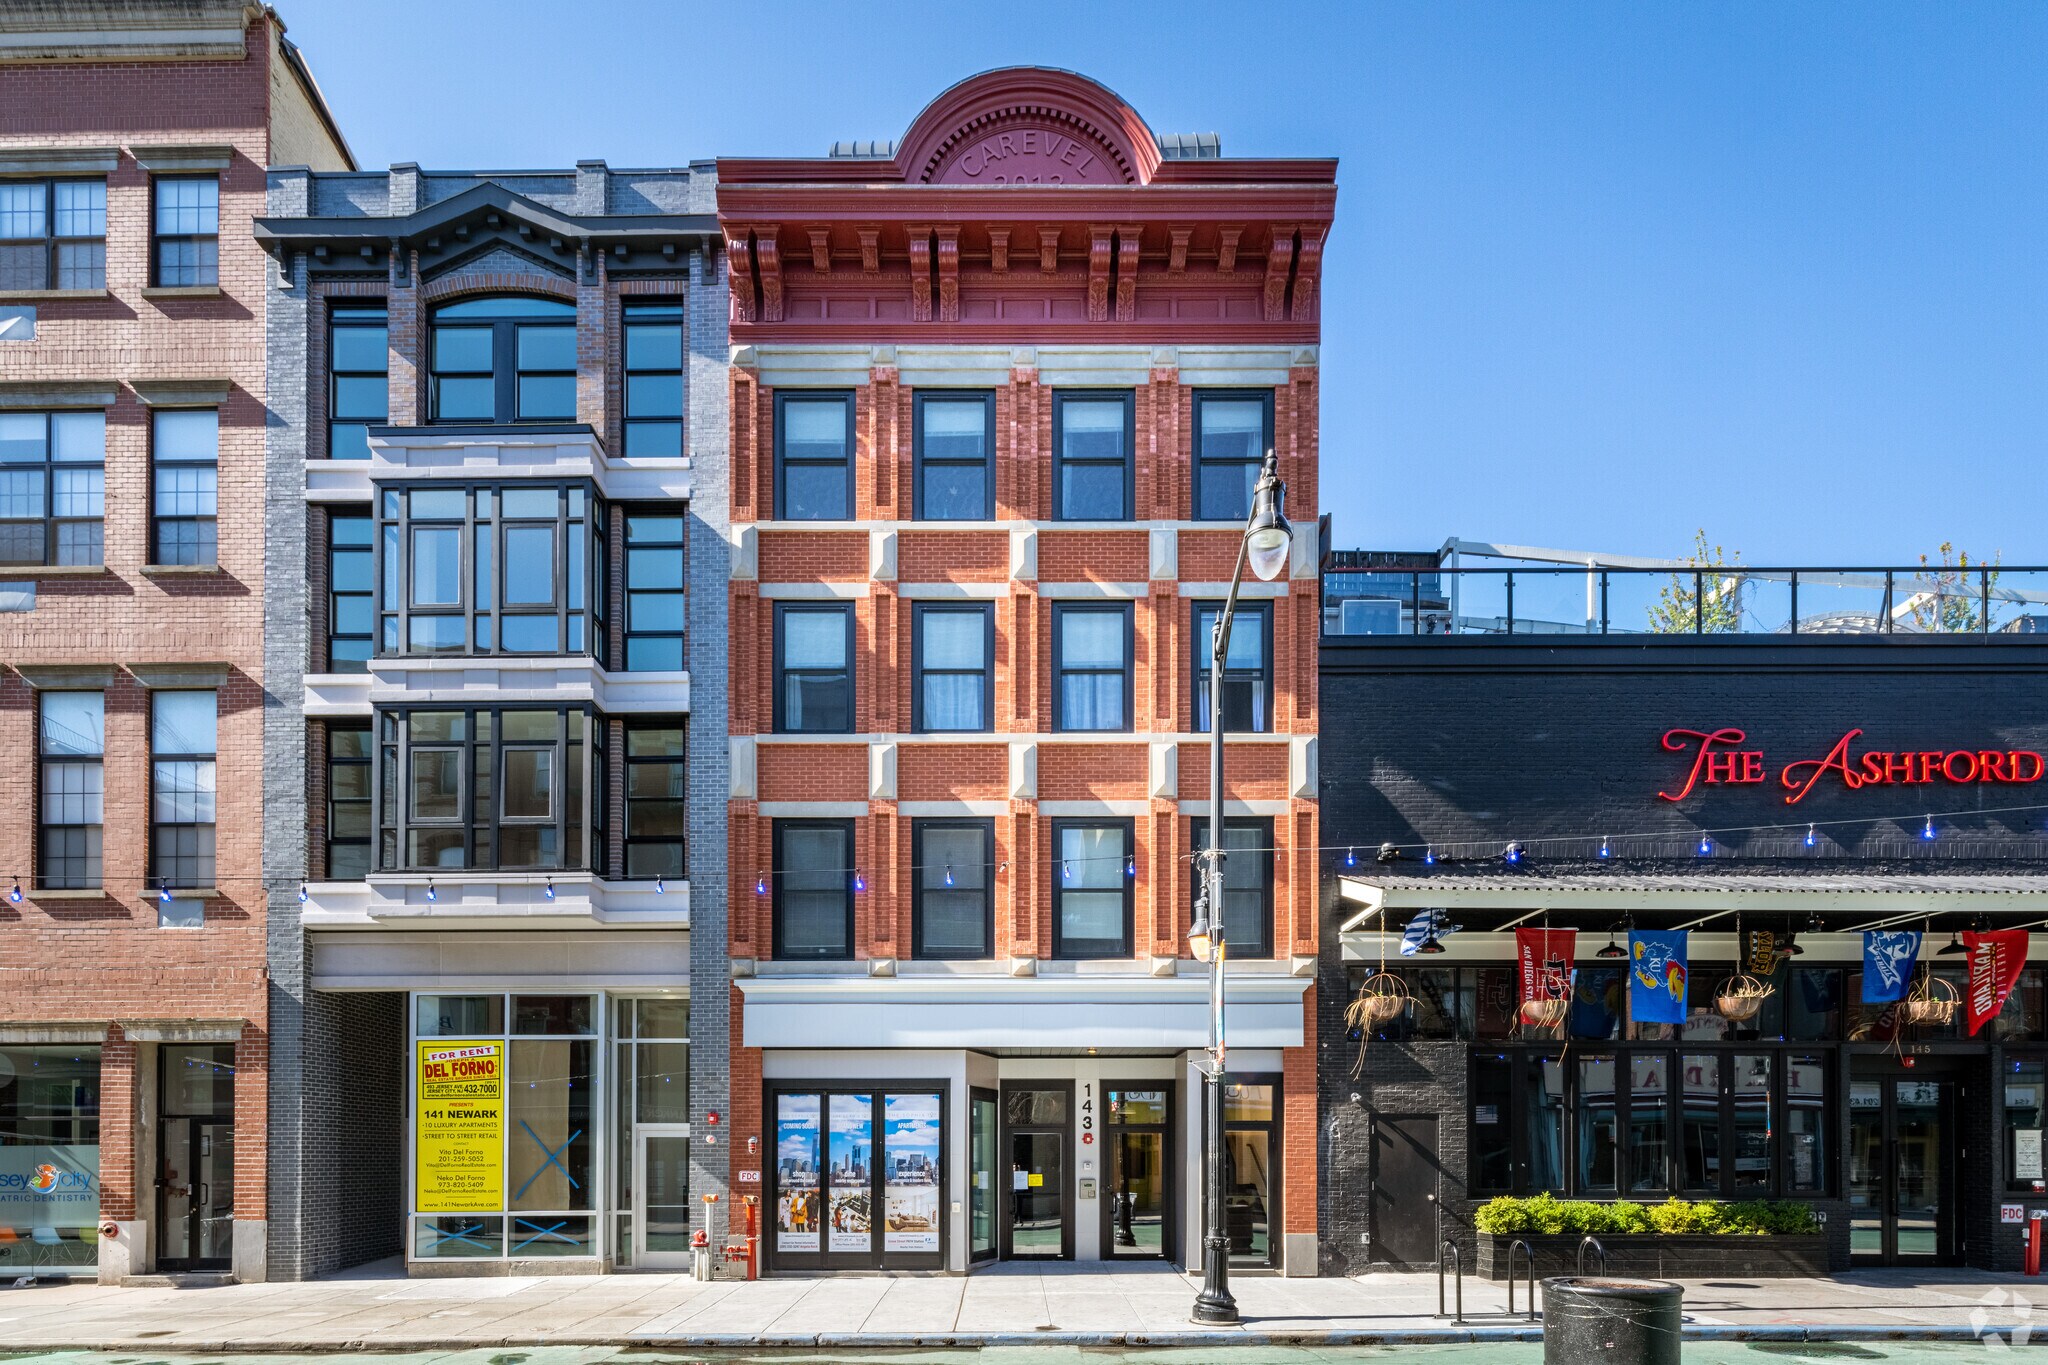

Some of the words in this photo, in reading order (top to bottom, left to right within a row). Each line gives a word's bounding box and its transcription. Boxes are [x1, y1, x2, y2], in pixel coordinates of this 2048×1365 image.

[960, 130, 1095, 178] CAREVEL
[1658, 728, 1766, 801] THE
[1781, 728, 2046, 804] ASHFORD
[1523, 945, 1532, 959] SAN
[1524, 961, 1534, 984] DIEGO
[1649, 958, 1660, 972] KU
[1525, 985, 1534, 1001] STA
[431, 1052, 456, 1060] FOR
[460, 1047, 492, 1057] RENT
[1912, 1045, 1930, 1054] 145
[425, 1064, 449, 1078] DEL
[452, 1060, 495, 1076] FORNO
[464, 1085, 497, 1093] 432-7000
[448, 1110, 497, 1118] NEWARK
[1082, 1083, 1092, 1130] 143
[60, 1171, 91, 1190] city
[2002, 1208, 2023, 1219] FDC
